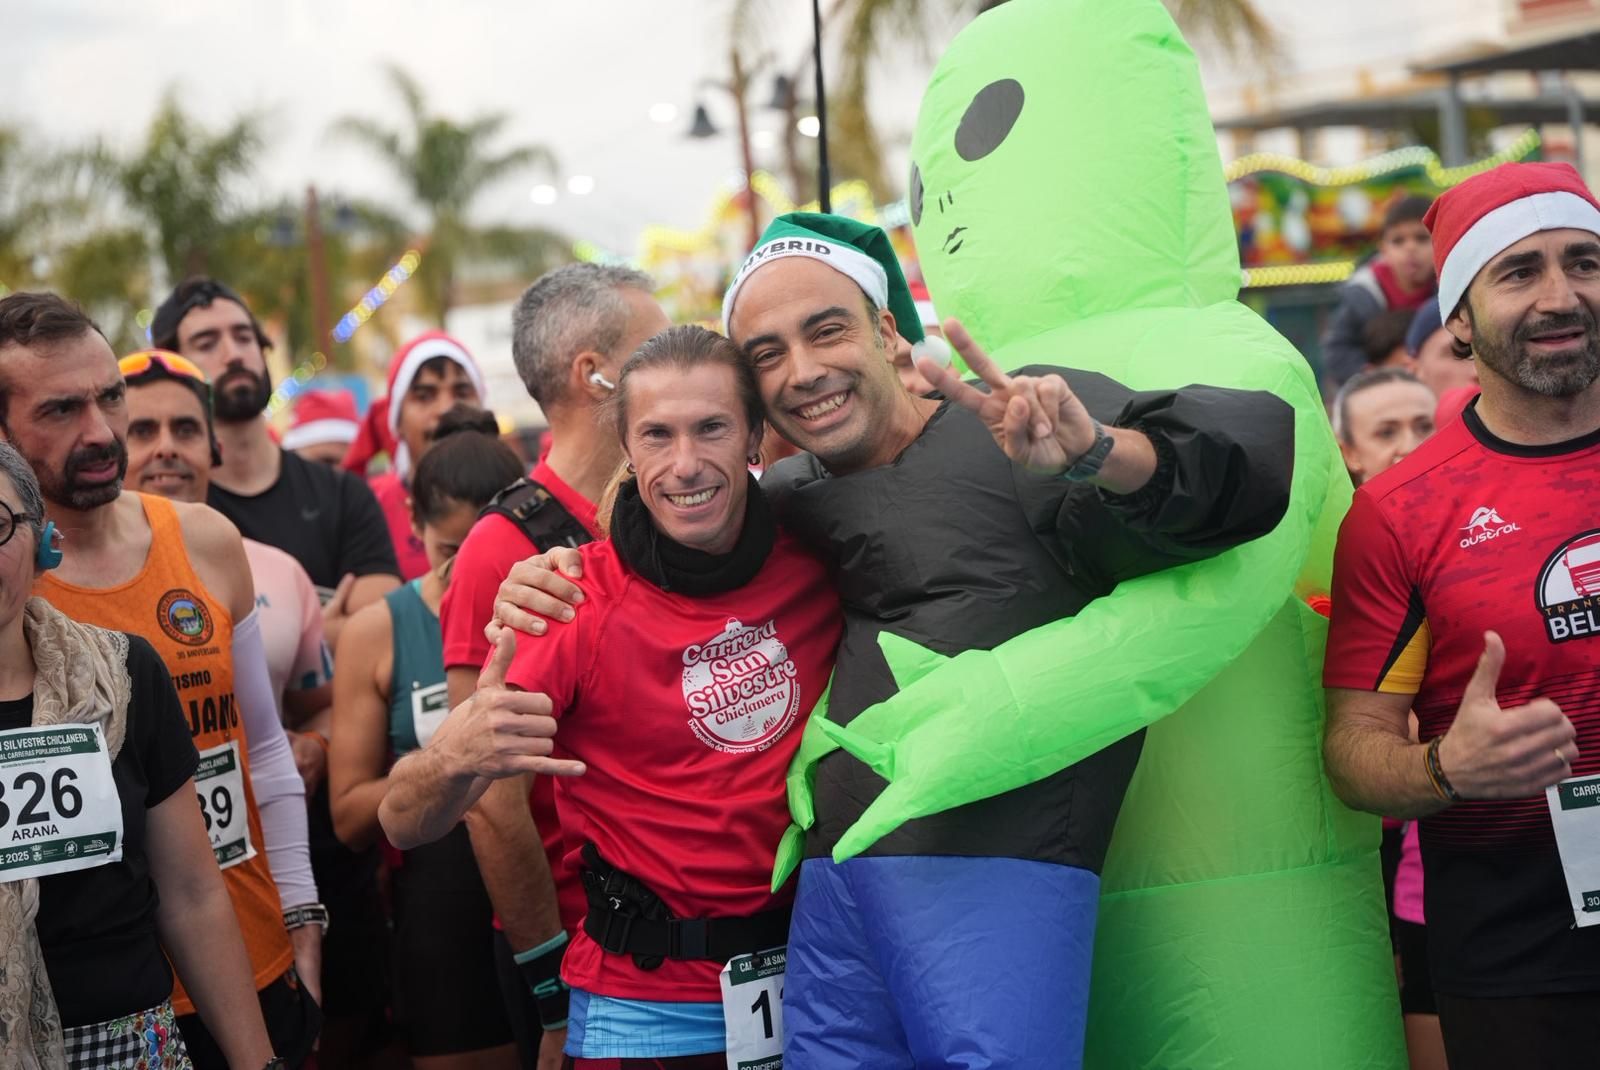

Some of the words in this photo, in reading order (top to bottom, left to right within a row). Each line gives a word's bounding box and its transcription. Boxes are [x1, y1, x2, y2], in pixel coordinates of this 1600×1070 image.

[742, 240, 831, 274] HYBRID
[682, 619, 777, 666] Carrera
[710, 651, 768, 682] San
[688, 660, 797, 717] Silvestre
[715, 690, 785, 725] Chiclanera
[3, 736, 46, 751] SILVESTRE
[46, 732, 89, 745] CHICLANERA
[11, 823, 60, 842] ARANA
[5, 850, 30, 865] 2025
